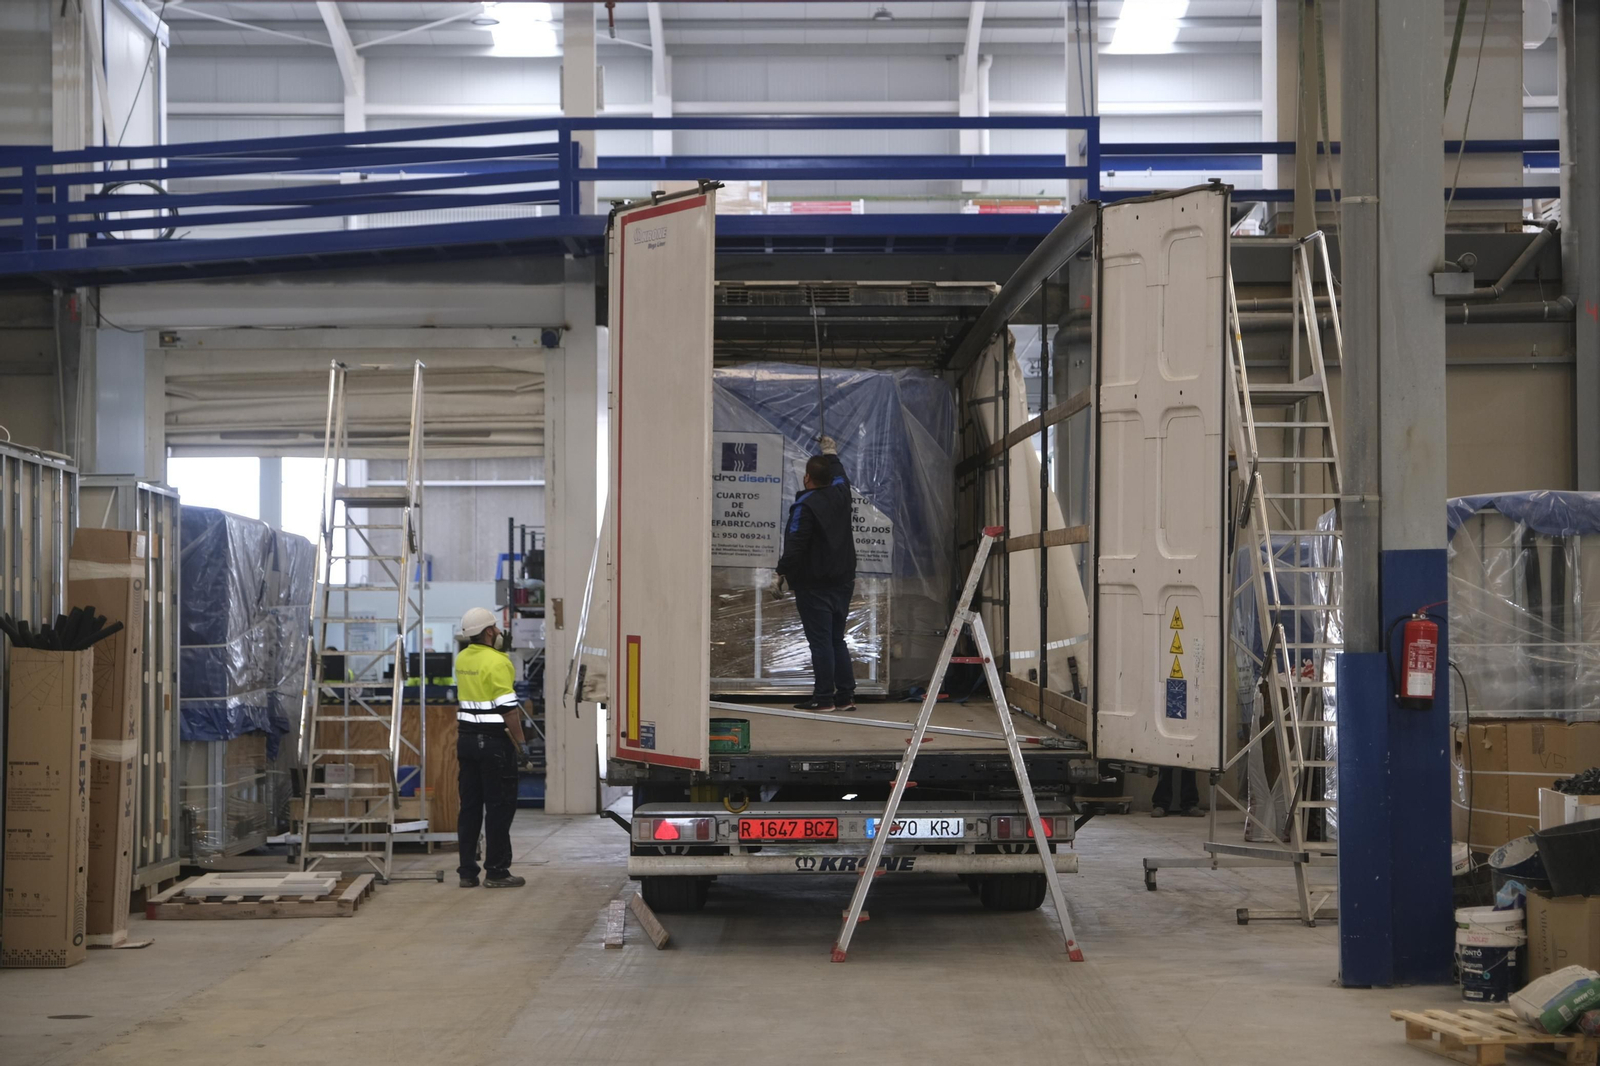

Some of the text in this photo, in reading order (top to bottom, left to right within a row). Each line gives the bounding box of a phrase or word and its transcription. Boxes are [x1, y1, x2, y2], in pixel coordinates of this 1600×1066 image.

[712, 473, 781, 484] dro diseño
[716, 491, 760, 500] CUARTOS
[731, 501, 744, 509] DE
[851, 497, 872, 505] RTO
[724, 509, 751, 518] BAÑO
[740, 532, 771, 540] 069241
[125, 719, 135, 818] K-FLX
[741, 821, 836, 837] R 1647 BCZ
[930, 820, 961, 836] KRJ
[1540, 909, 1548, 954] Villeroy
